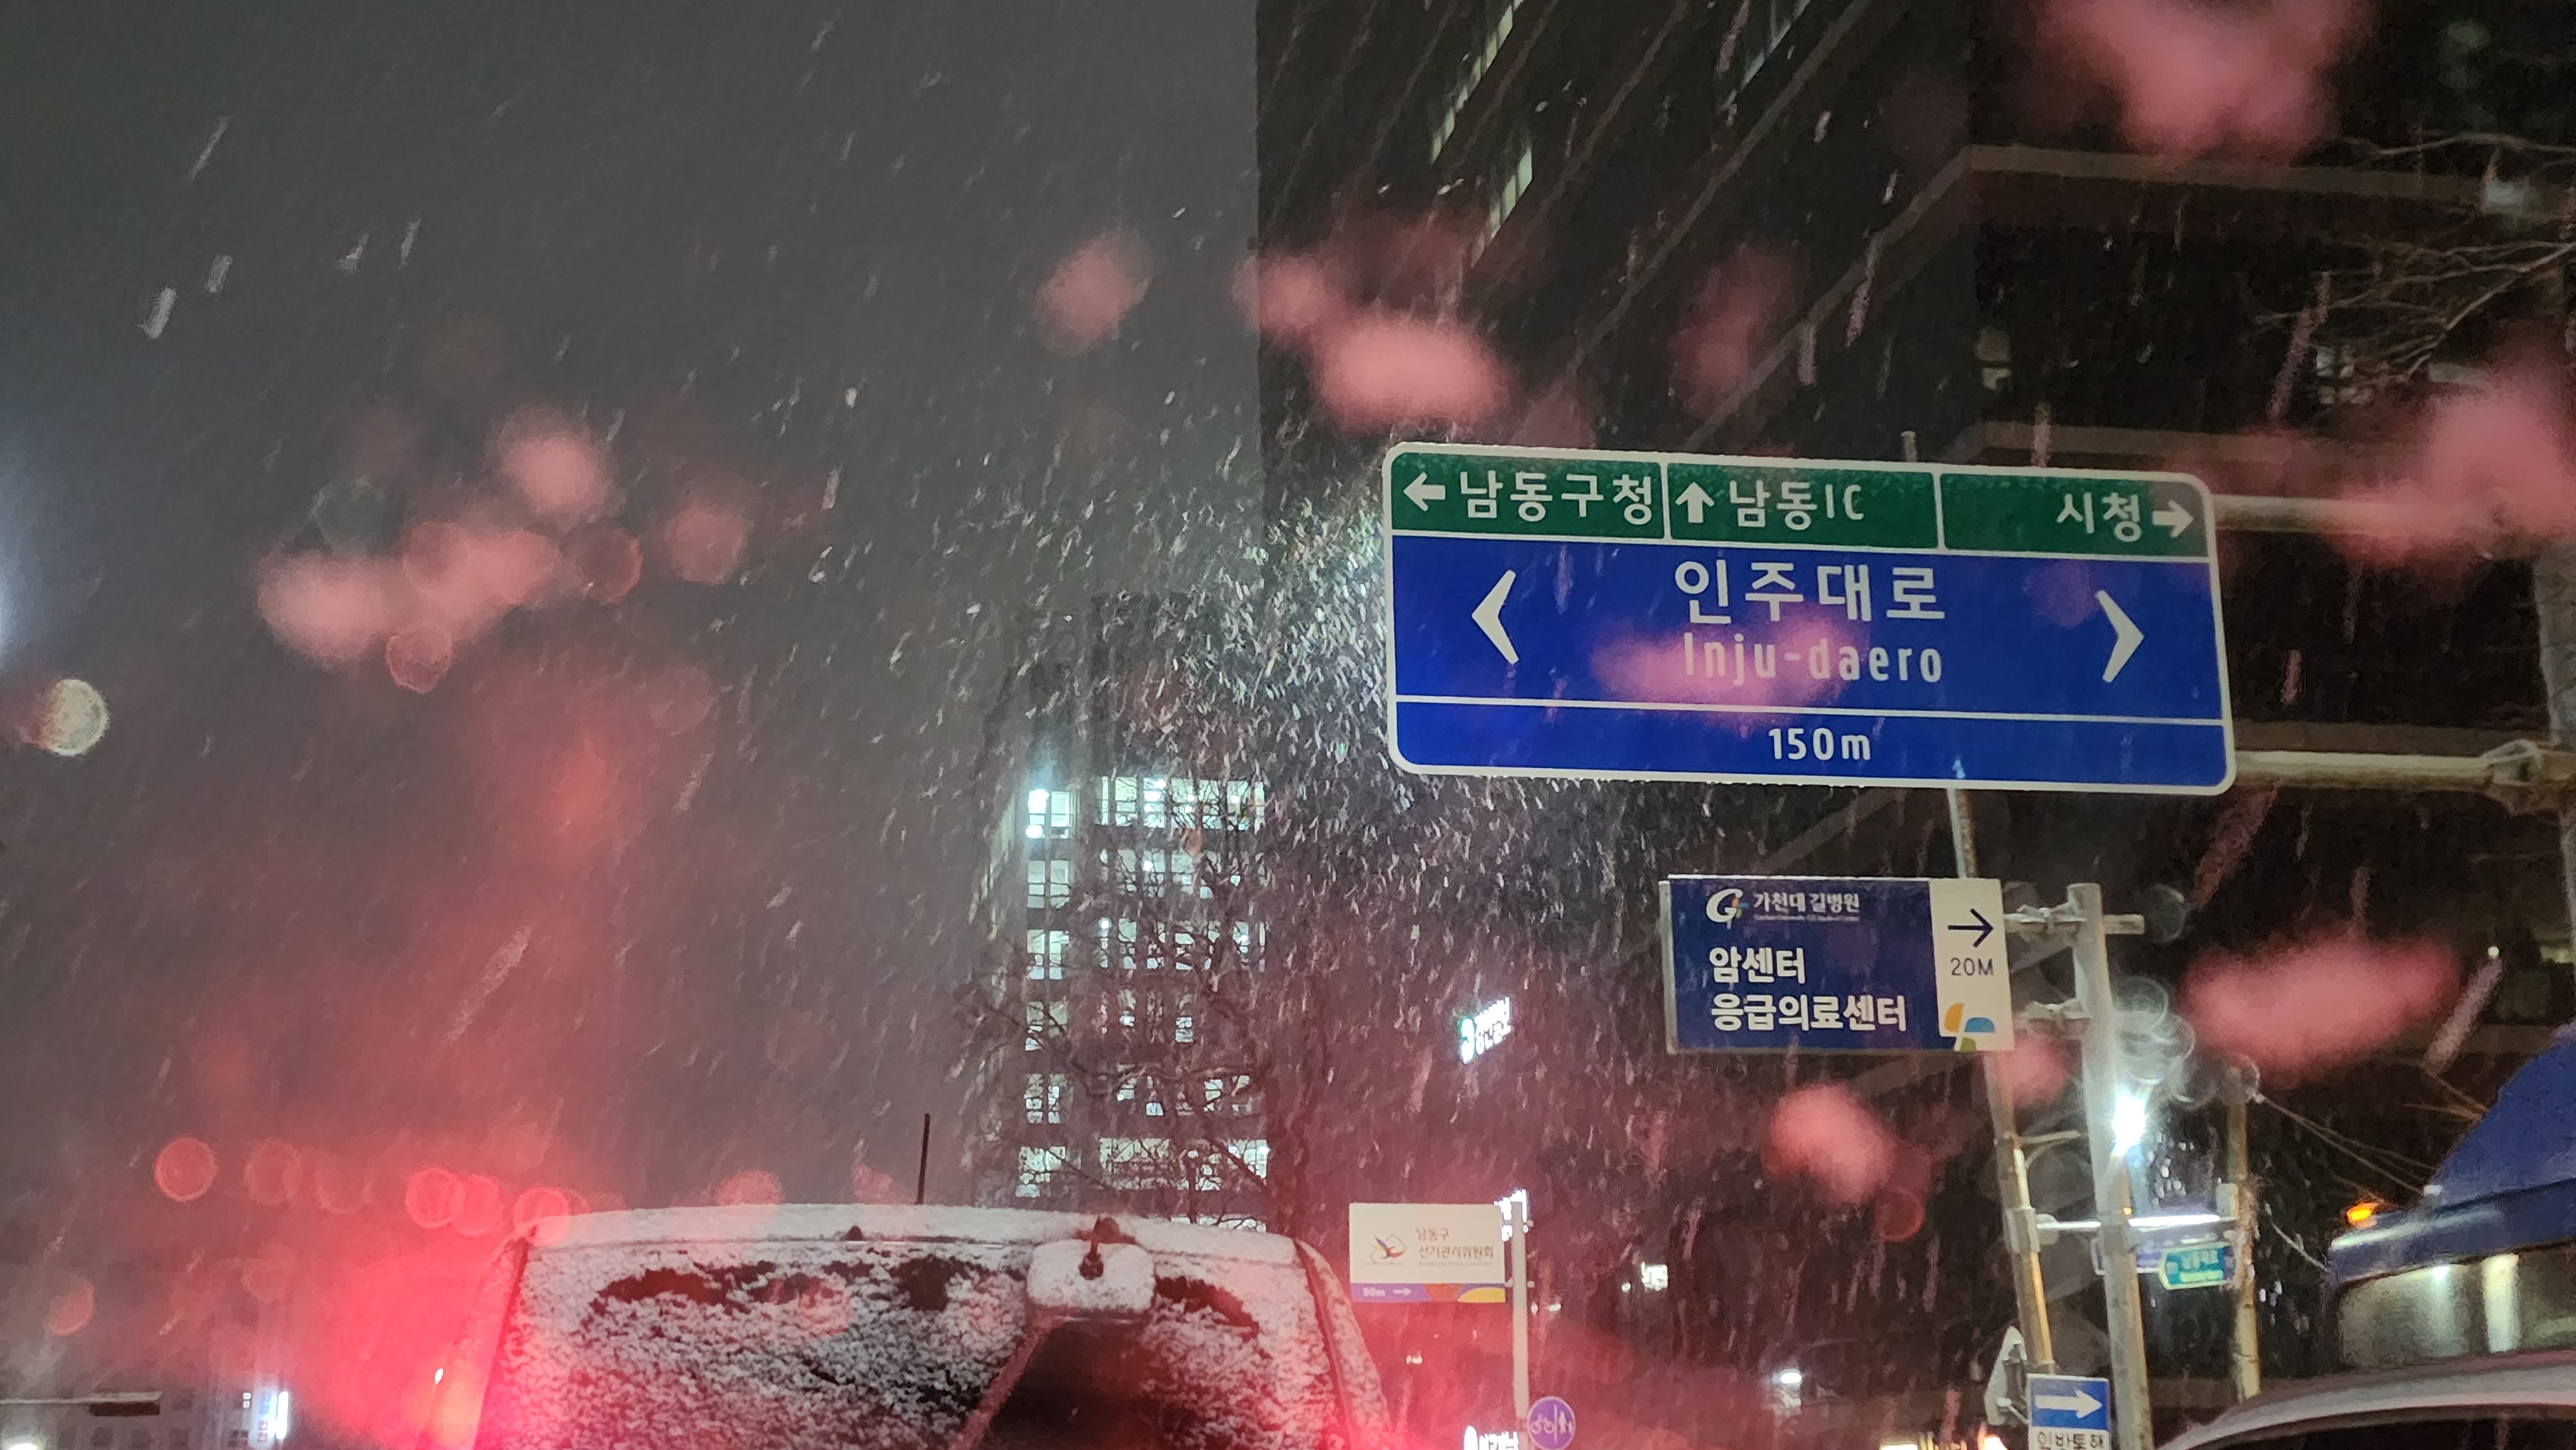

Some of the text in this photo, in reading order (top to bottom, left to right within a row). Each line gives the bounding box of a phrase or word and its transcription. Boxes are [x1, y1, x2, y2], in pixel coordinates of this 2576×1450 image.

[1460, 469, 1655, 525] 남동구청
[1729, 478, 1865, 530] 남동IC
[2056, 493, 2143, 543] 시청
[1674, 559, 1946, 624] 인주대로
[1683, 632, 1944, 686] Inju-daero
[1768, 728, 1871, 762] 150m
[1753, 891, 1861, 914] 가천대 길병원
[1709, 946, 1806, 983] 암센터
[1950, 957, 1994, 976] 20M
[1711, 994, 1907, 1031] 응급의료센터
[1416, 1227, 1449, 1241] 남동구
